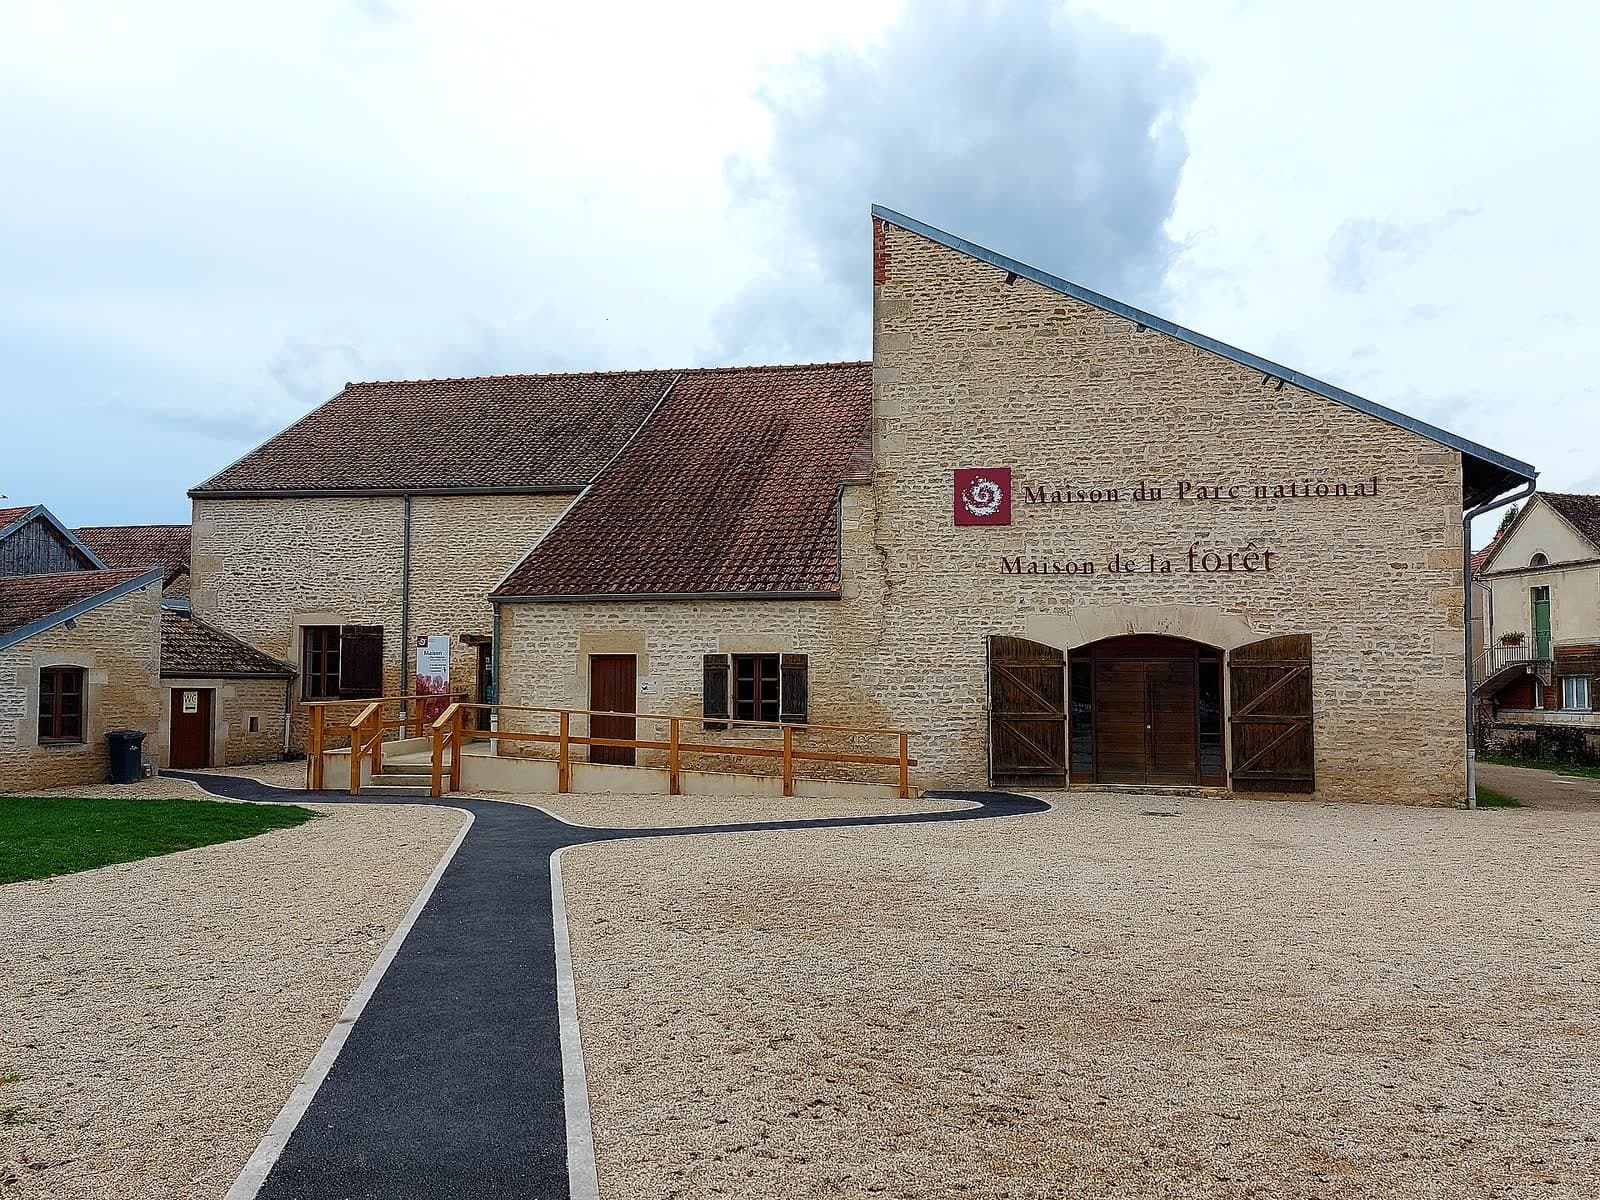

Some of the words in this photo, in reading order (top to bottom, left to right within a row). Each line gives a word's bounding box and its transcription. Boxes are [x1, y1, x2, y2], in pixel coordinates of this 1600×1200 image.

[1024, 485, 1118, 503] Maison
[1132, 482, 1162, 501] du
[1177, 481, 1239, 500] Parc
[1254, 476, 1379, 498] national
[1001, 555, 1094, 574] Maison
[1107, 553, 1136, 573] de
[1150, 553, 1172, 573] la
[1187, 541, 1278, 573] forêt
